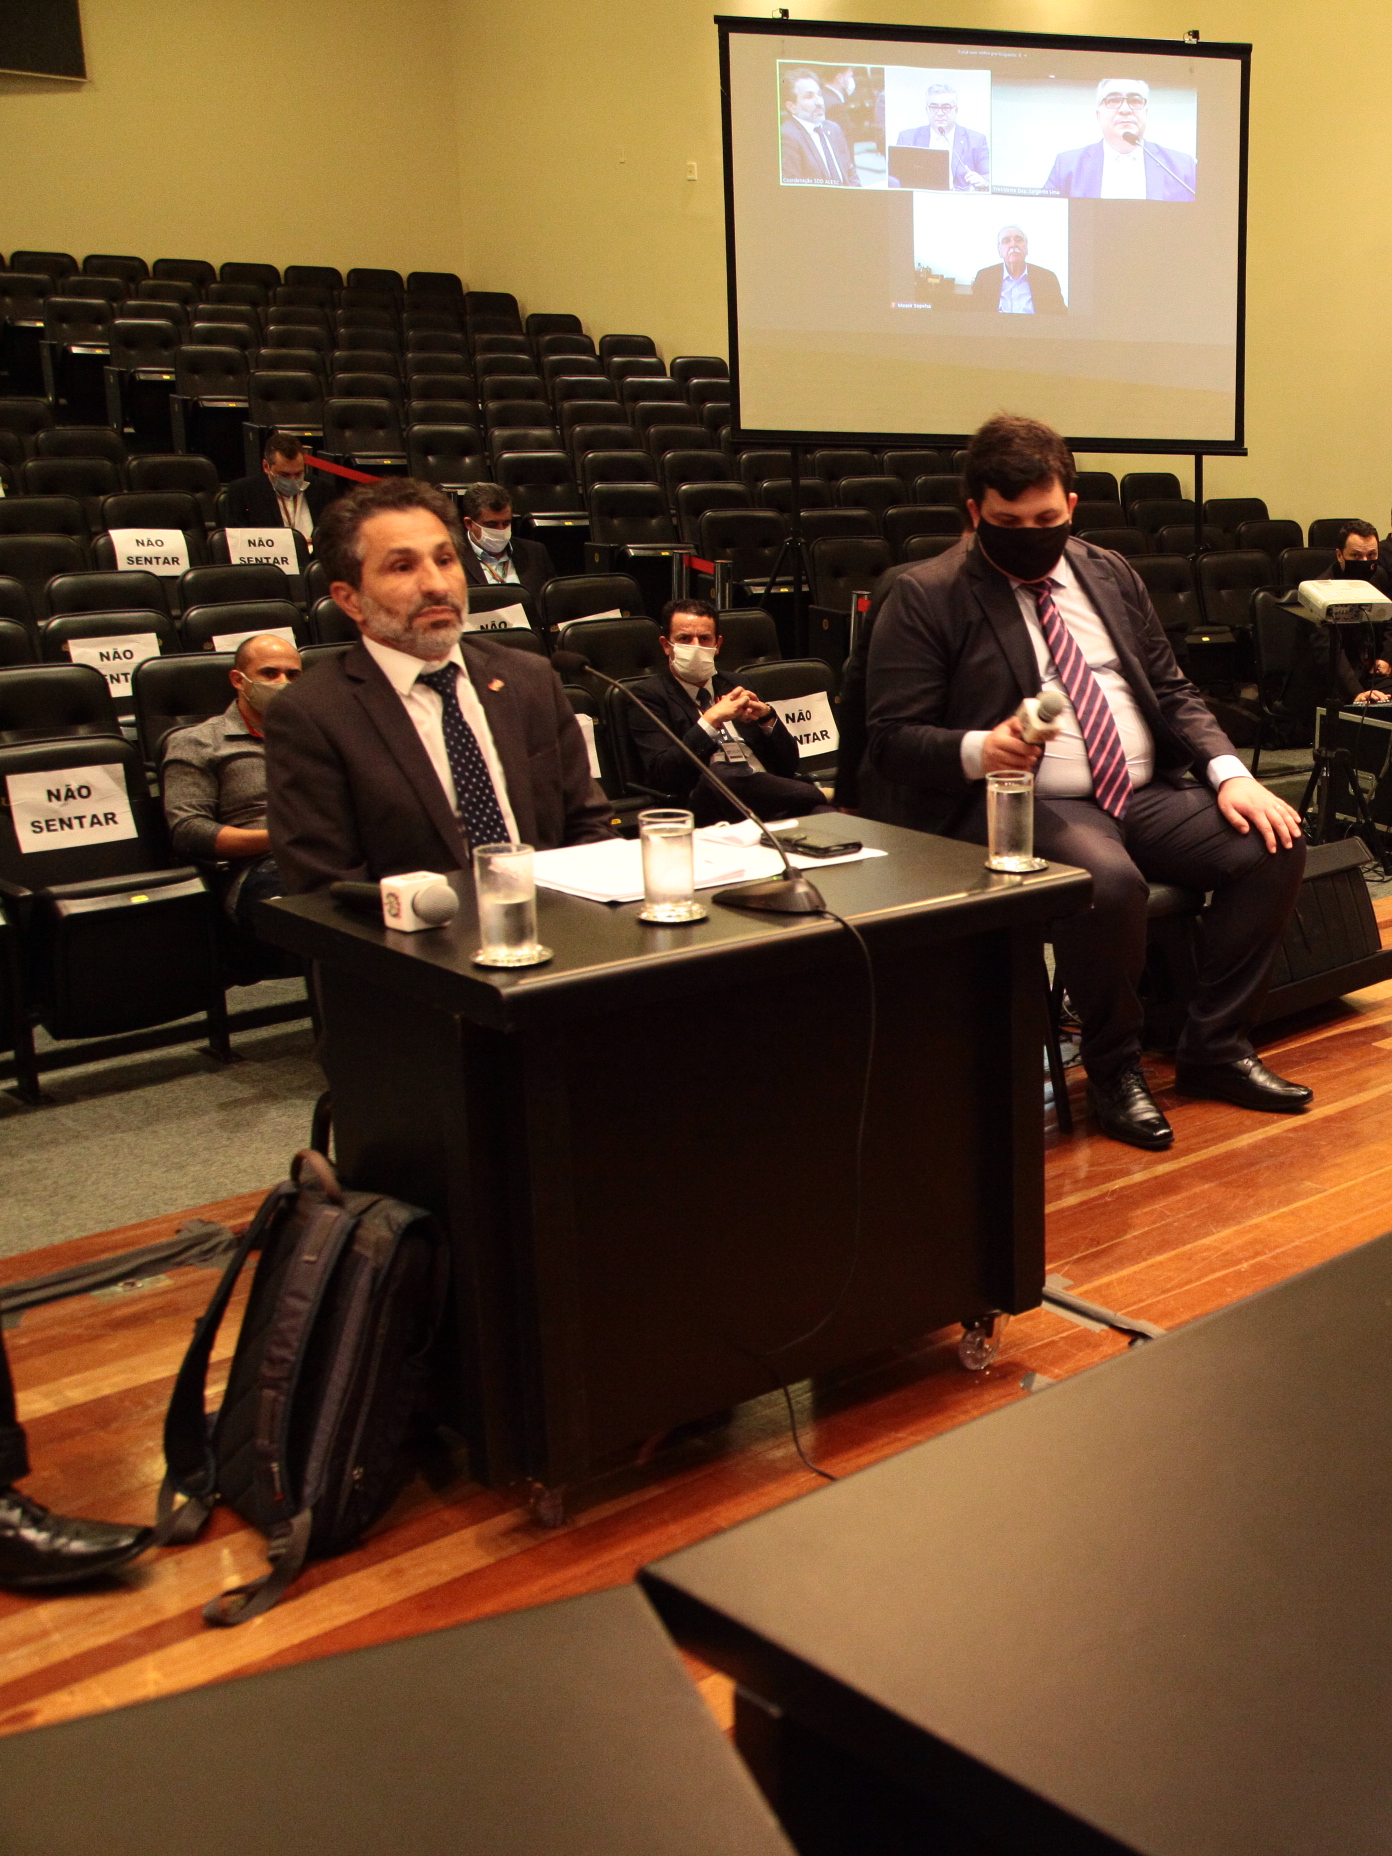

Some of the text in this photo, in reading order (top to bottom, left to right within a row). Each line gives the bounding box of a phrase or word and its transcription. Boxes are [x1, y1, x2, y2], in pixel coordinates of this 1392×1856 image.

[136, 537, 164, 547] NÃO
[248, 537, 275, 548] NÃO
[127, 556, 180, 566] SENTAR
[99, 648, 134, 662] NÃO
[785, 709, 812, 724] NÃO
[794, 729, 831, 745] NTAR
[46, 784, 92, 803] NÃO
[31, 811, 118, 834] SENTAR
